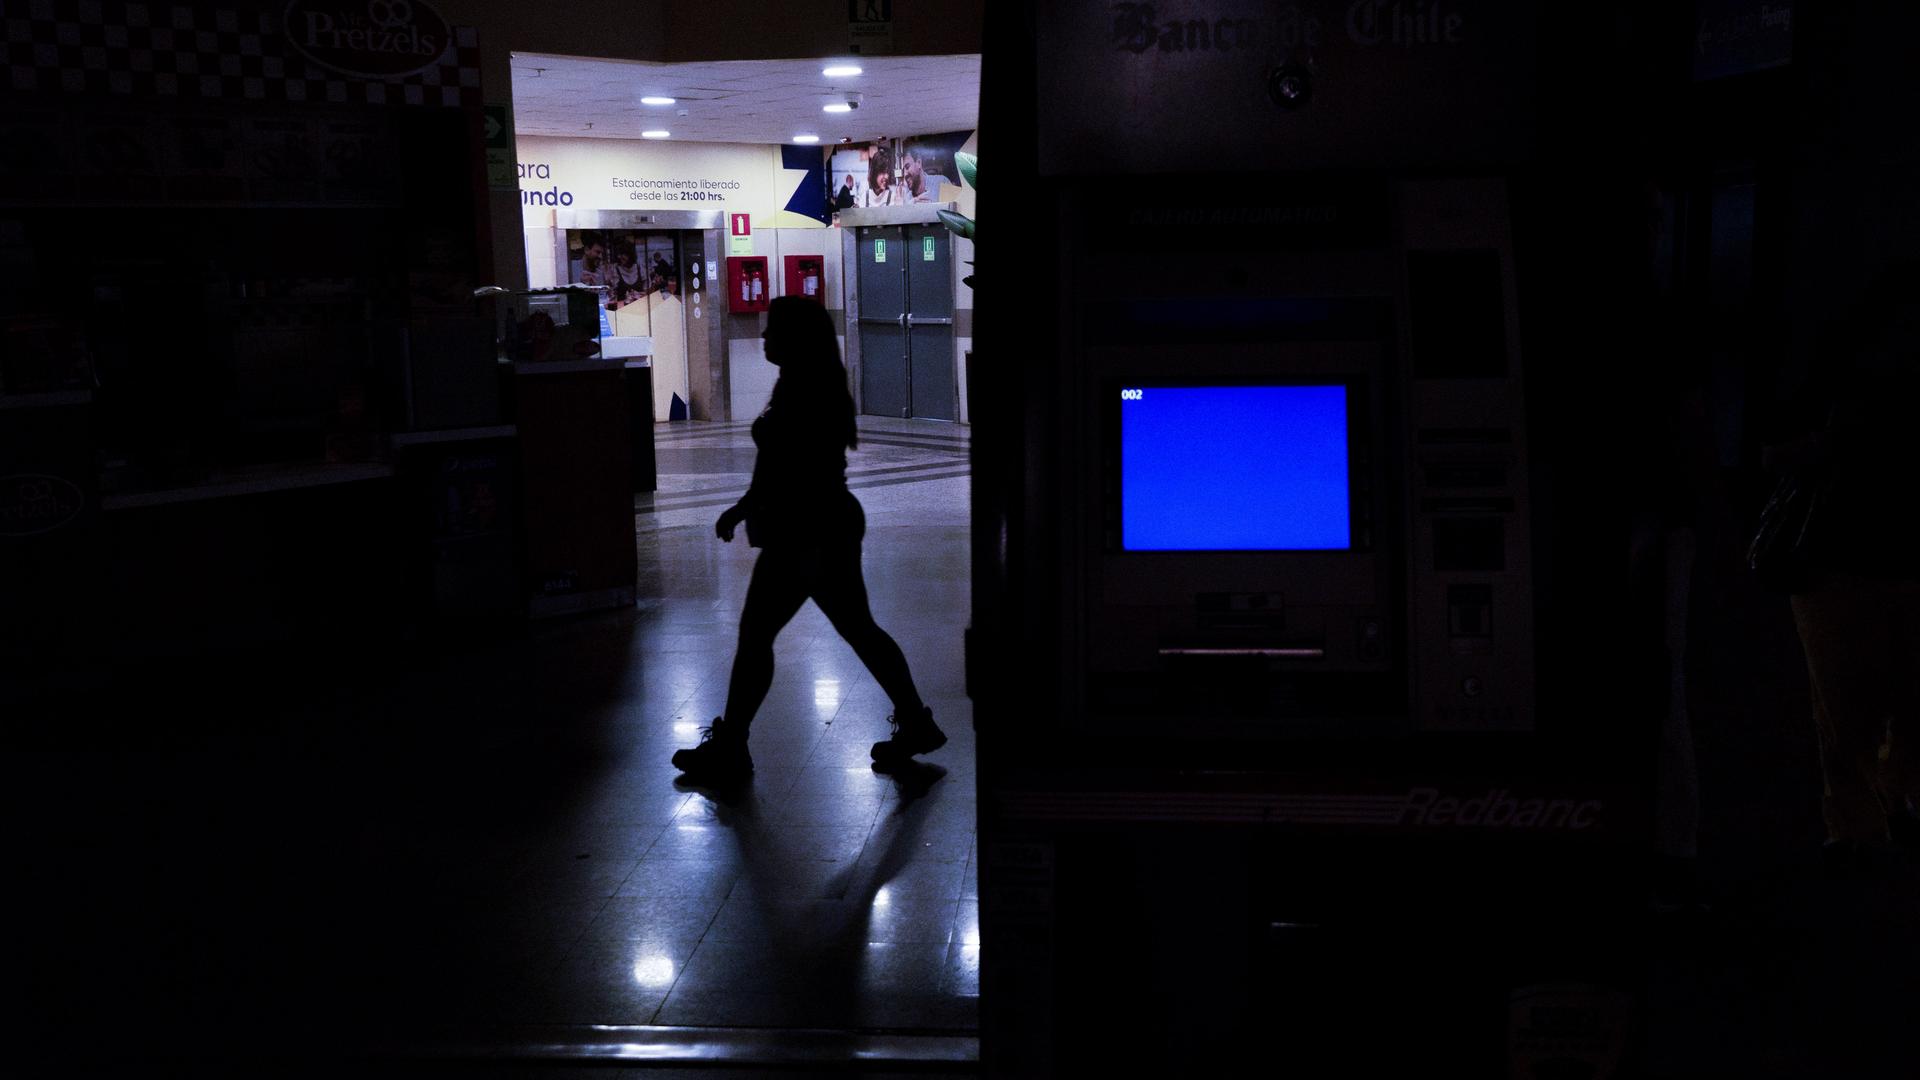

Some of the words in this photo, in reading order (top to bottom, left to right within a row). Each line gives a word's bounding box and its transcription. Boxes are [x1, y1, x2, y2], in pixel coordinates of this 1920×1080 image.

[303, 10, 437, 56] Pretzels
[1113, 1, 1257, 54] Banco
[1345, 0, 1463, 49] Chile
[612, 177, 698, 190] Estacionamiento
[699, 179, 741, 191] liberado
[630, 191, 662, 202] desde
[663, 191, 679, 202] las
[680, 192, 706, 202] 21:00
[707, 192, 726, 202] hrs.
[1121, 388, 1143, 401] 002
[1394, 786, 1603, 830] Redbanc
